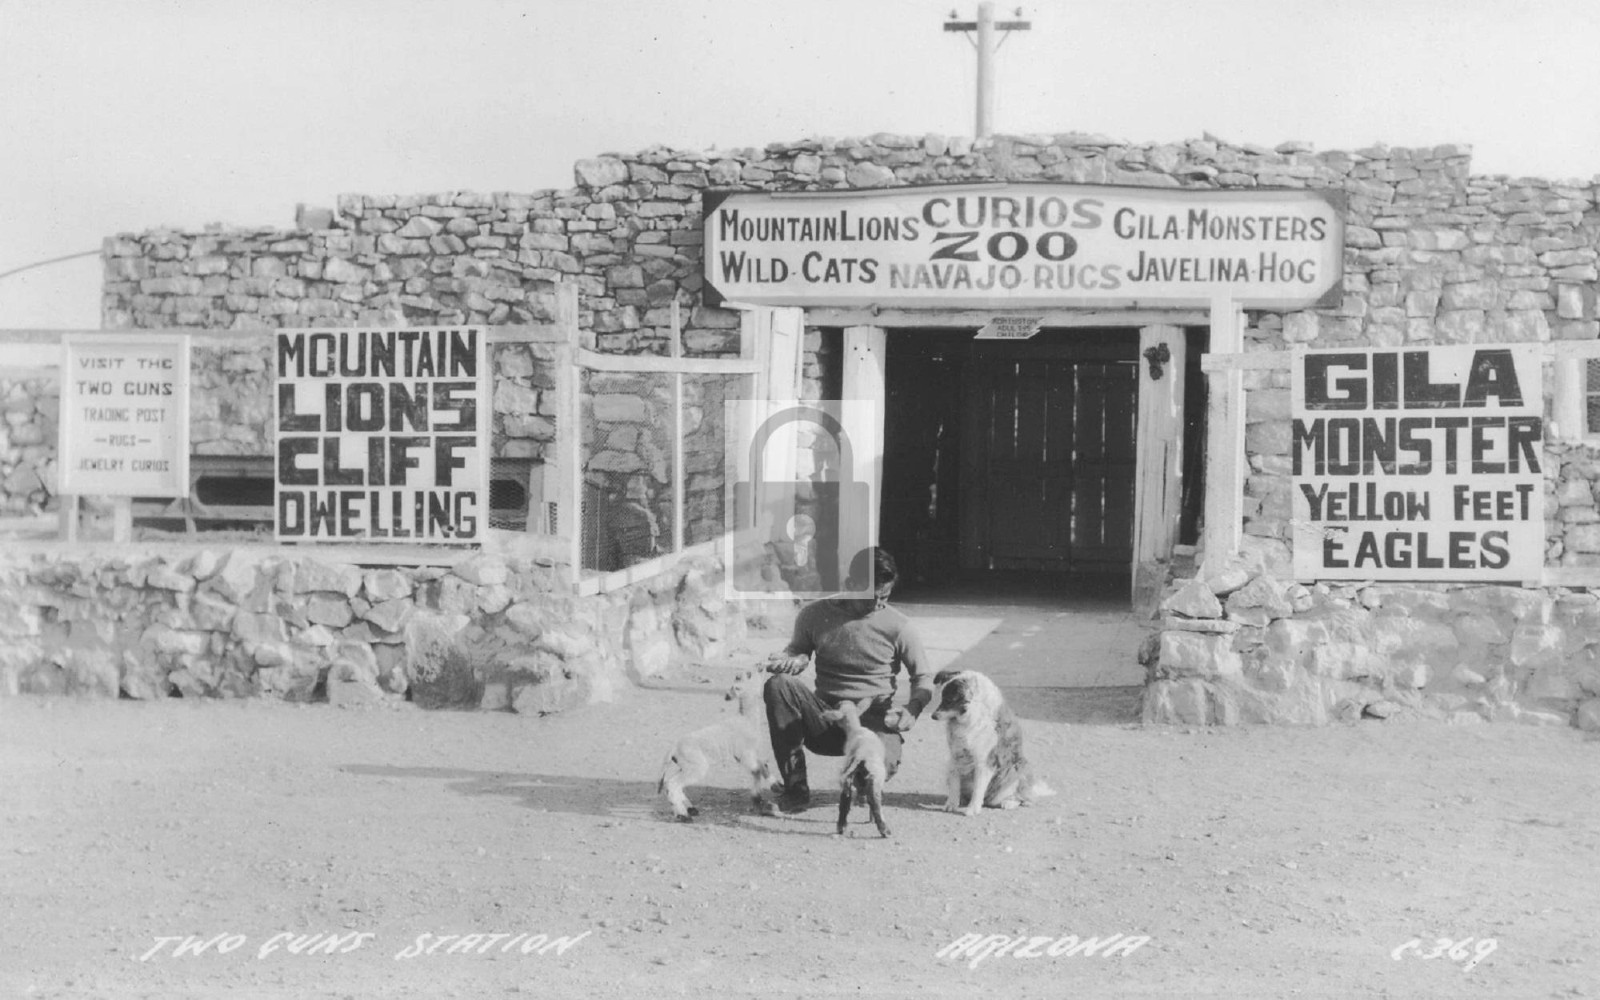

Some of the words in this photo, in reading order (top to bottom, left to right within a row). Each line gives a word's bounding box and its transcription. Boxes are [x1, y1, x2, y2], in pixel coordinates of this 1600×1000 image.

[840, 210, 920, 243] LIONS
[921, 196, 1104, 230] CURIOS
[1113, 206, 1180, 240] GILA
[1186, 208, 1327, 242] MONSTERS
[929, 230, 1078, 263] ZOO
[801, 250, 879, 284] CATS
[889, 262, 1022, 290] NAVAJO
[1033, 263, 1122, 290] RUGS
[1126, 250, 1250, 283] JAVELINA
[1258, 251, 1316, 284] HOG
[79, 358, 125, 369] VISIT
[137, 358, 173, 369] THE
[278, 329, 477, 378] MOUNTAIN
[77, 381, 112, 395] TWO
[124, 382, 173, 396] GUNS
[1304, 348, 1525, 411] GILA
[83, 407, 129, 422] TRADING
[136, 408, 166, 422] POST
[278, 381, 477, 432] LIONS
[278, 436, 477, 486] CLIFF
[1292, 415, 1543, 476] MONSTER
[78, 458, 124, 472] JEWELRY
[131, 459, 170, 472] CURIOS
[278, 490, 477, 538] DWELLING
[1299, 482, 1431, 522] YELLOW
[1453, 484, 1535, 521] FEET
[1322, 526, 1511, 570] EAGLES
